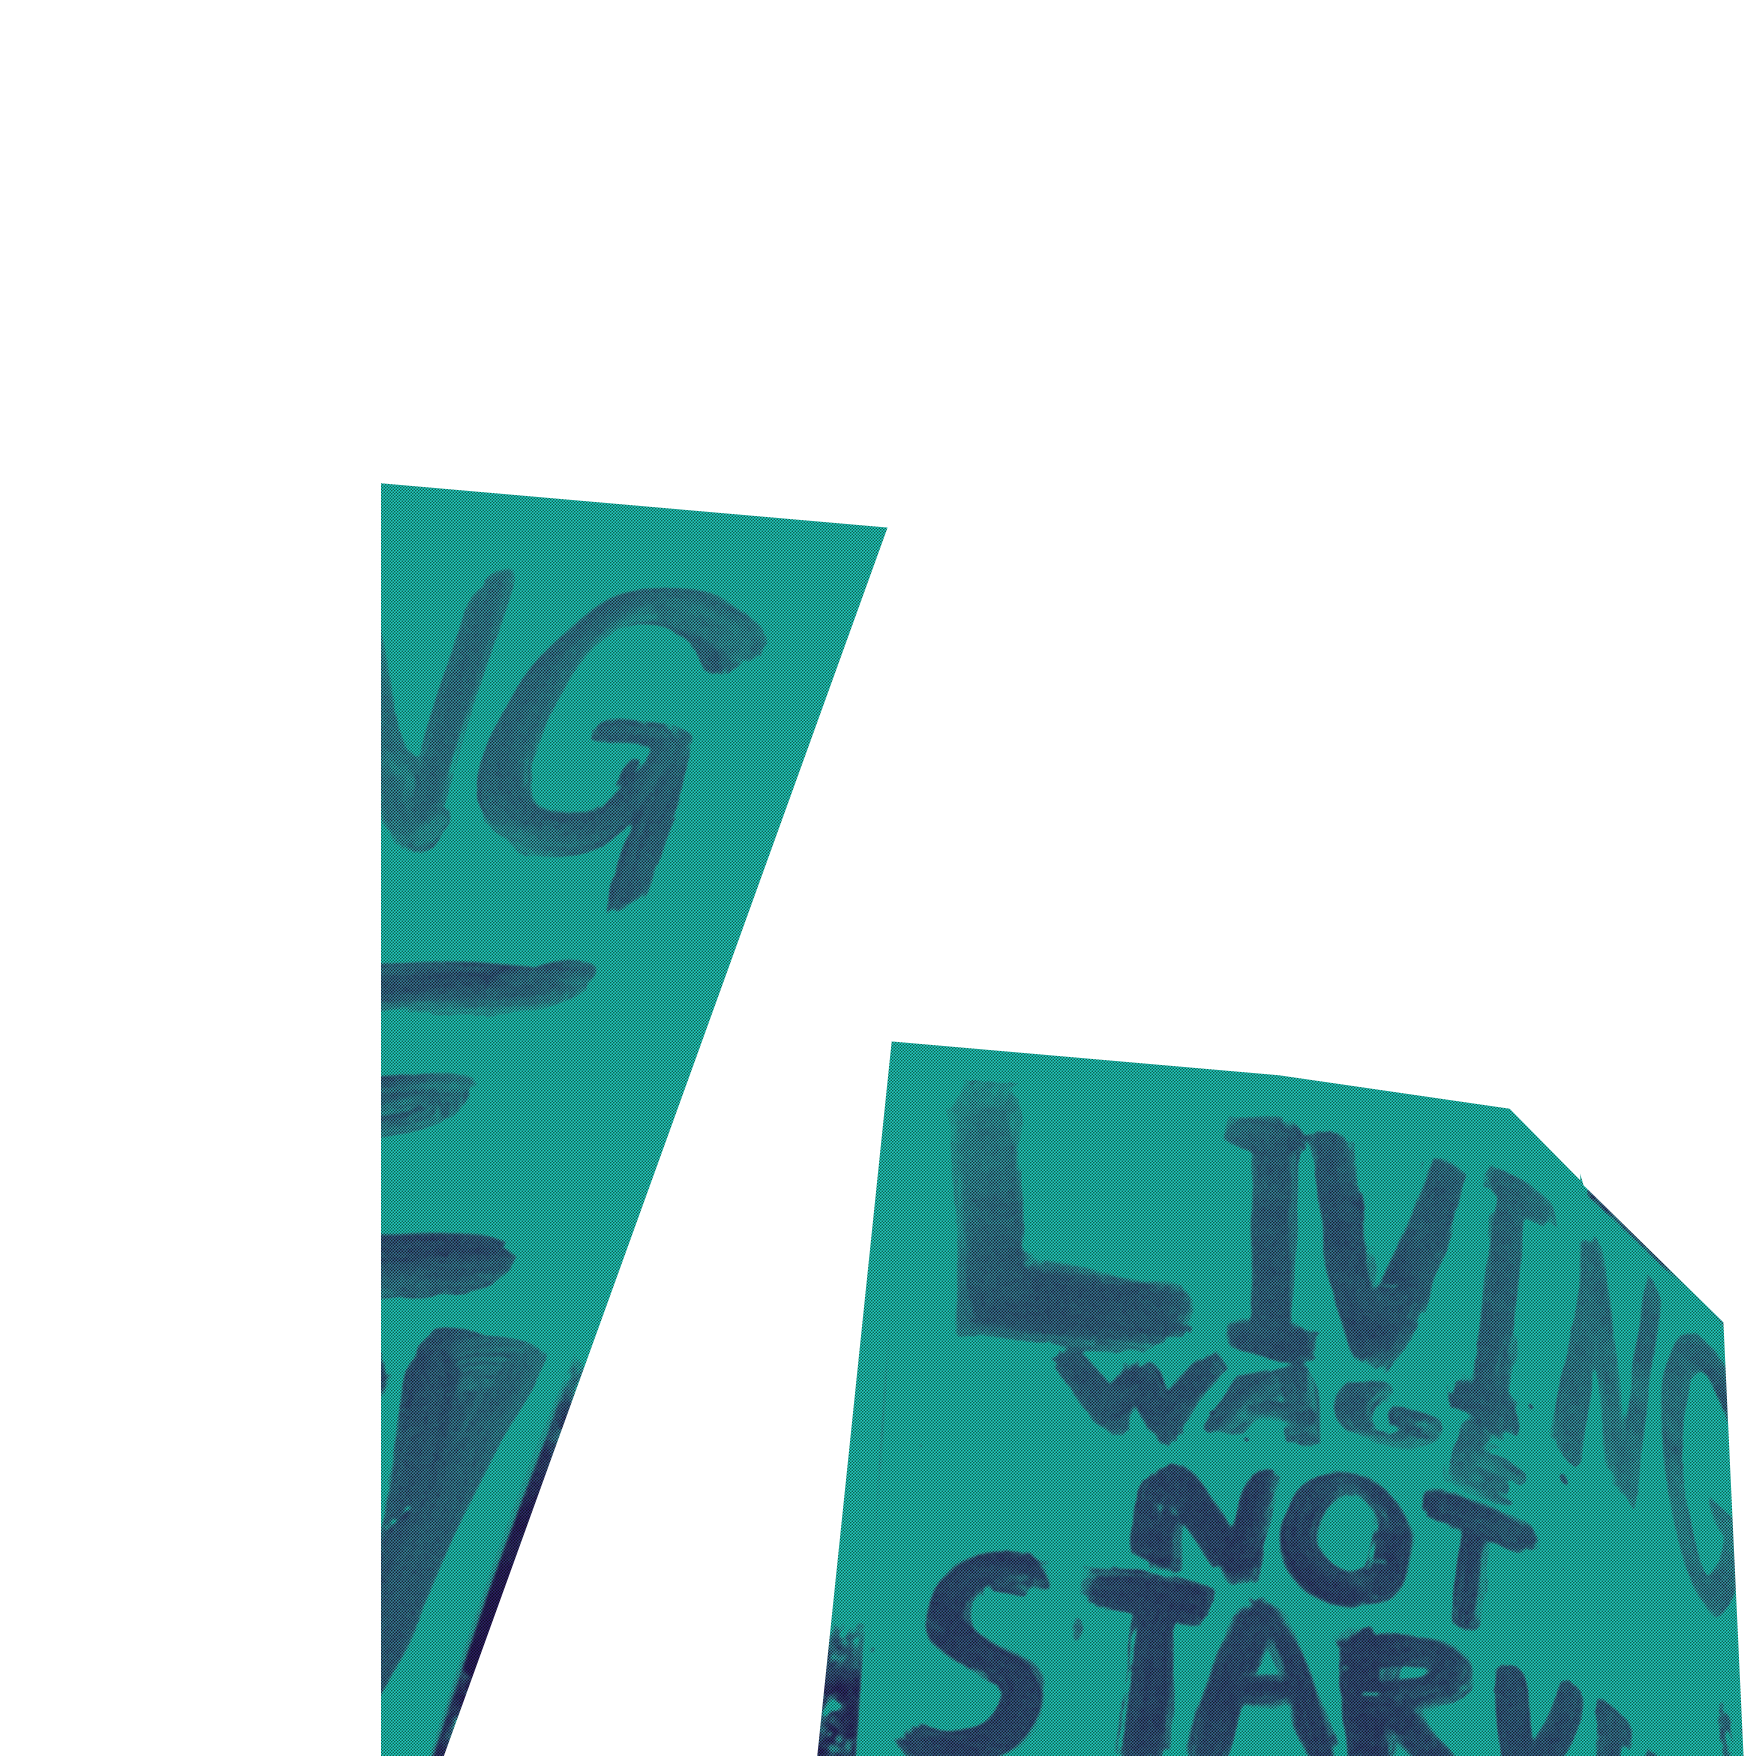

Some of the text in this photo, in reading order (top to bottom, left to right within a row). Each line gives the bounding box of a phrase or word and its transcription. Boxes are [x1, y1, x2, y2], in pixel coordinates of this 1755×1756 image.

[949, 1080, 1737, 1617] LIVING
[1053, 1348, 1527, 1505] WAGE
[1130, 1463, 1539, 1630] NOT
